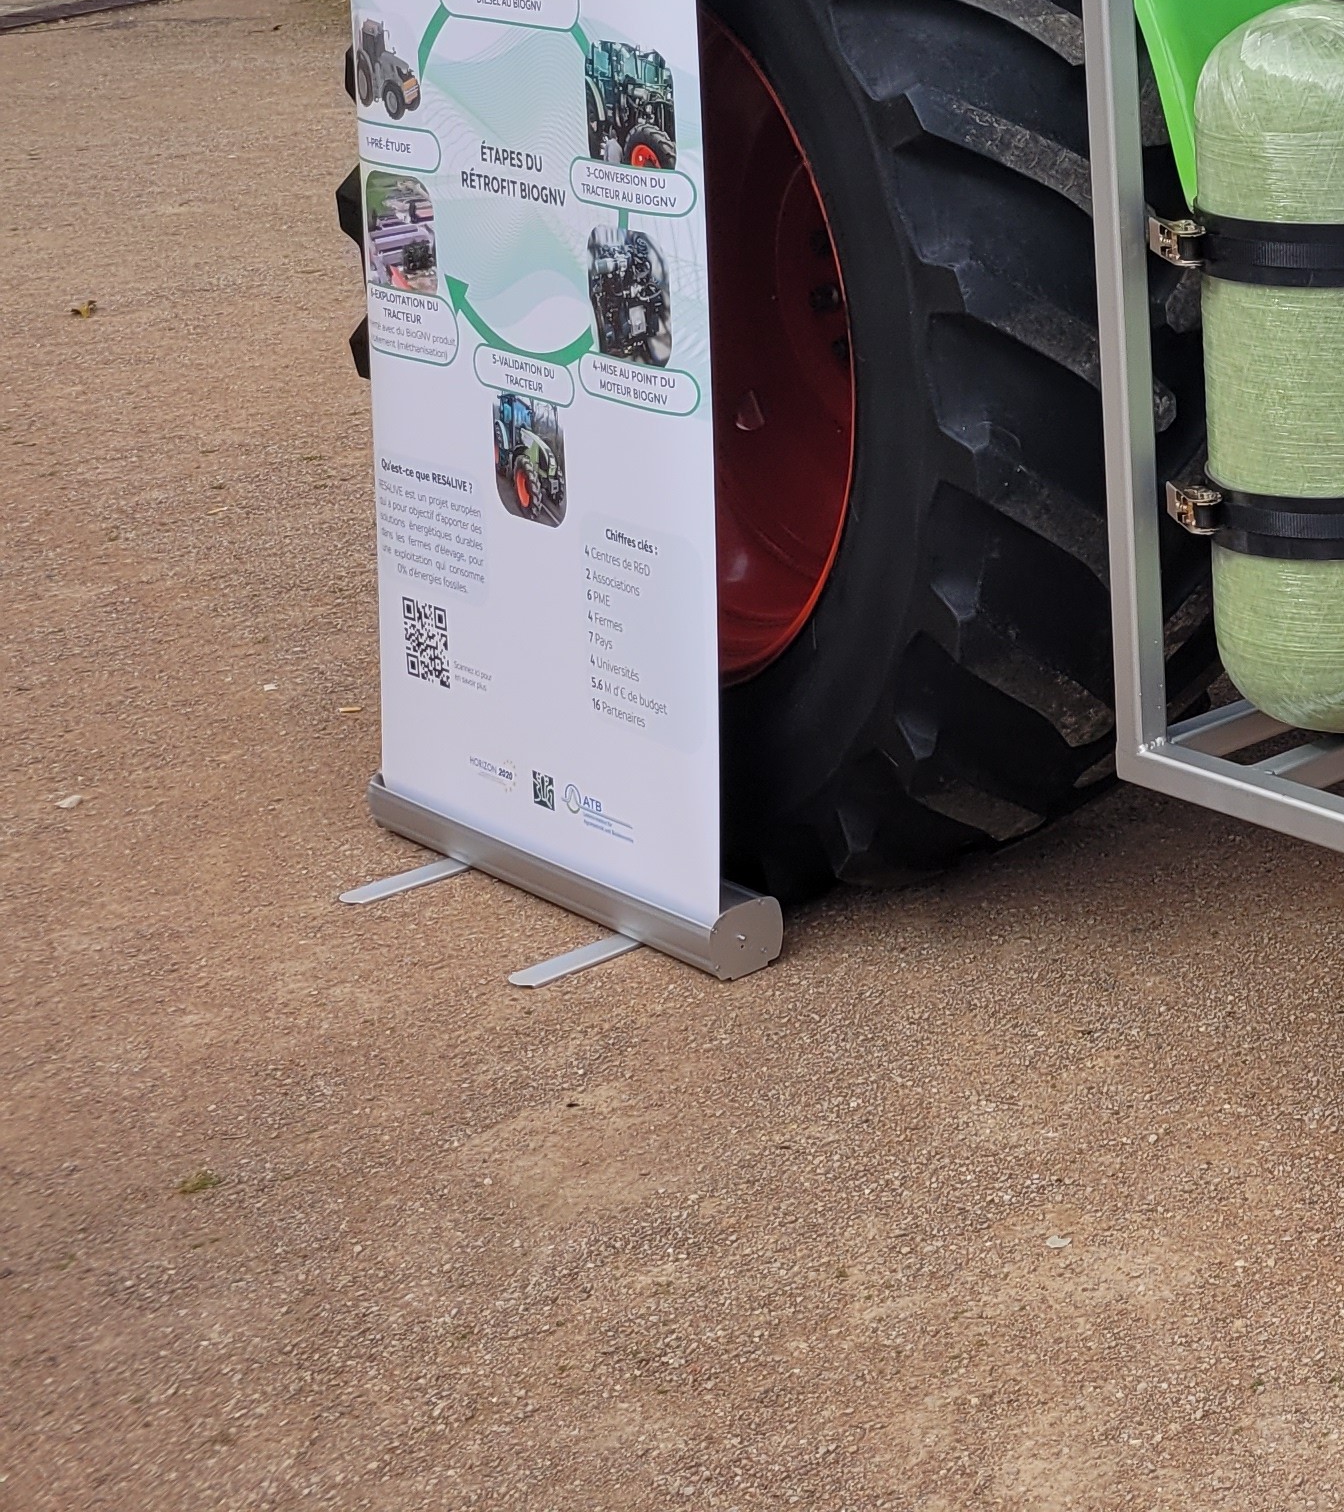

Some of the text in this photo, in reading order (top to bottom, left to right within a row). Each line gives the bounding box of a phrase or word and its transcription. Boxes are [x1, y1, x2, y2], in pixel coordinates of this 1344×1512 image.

[480, 141, 543, 173] ÉTAPES DU
[461, 166, 566, 208] RÉTROFIT BIOGNV
[586, 167, 666, 189] 3-CONVERSION DU
[581, 183, 676, 207] TRACTEUR AU BIOGNV
[383, 307, 422, 324] TRACTEUR
[427, 300, 438, 311] DU
[492, 354, 555, 380] 5-VALIDATION DU
[593, 360, 676, 389] 4-MISE AU POINT DU
[505, 373, 543, 393] TRACTEUR
[600, 379, 668, 406] MOTEUR BIOGNV
[381, 458, 414, 477] Qu'est-ce
[416, 470, 430, 482] que
[432, 472, 467, 492] RES4LIVE
[605, 528, 636, 548] Chiffres
[637, 539, 653, 554] clés
[585, 545, 589, 557] 4
[591, 547, 620, 567] Centres
[622, 558, 632, 570] de
[586, 568, 640, 596] 2 Associations
[587, 589, 610, 607] 6 PME
[588, 609, 623, 633] 4 Fermes
[589, 631, 613, 650] 7 Pays
[590, 653, 640, 682] 4 Universités
[605, 681, 611, 694] M
[628, 690, 637, 704] de
[640, 693, 667, 715] budget
[592, 697, 646, 728] 16 Partenaires
[498, 767, 513, 780] 2020
[583, 795, 602, 812] ATB
